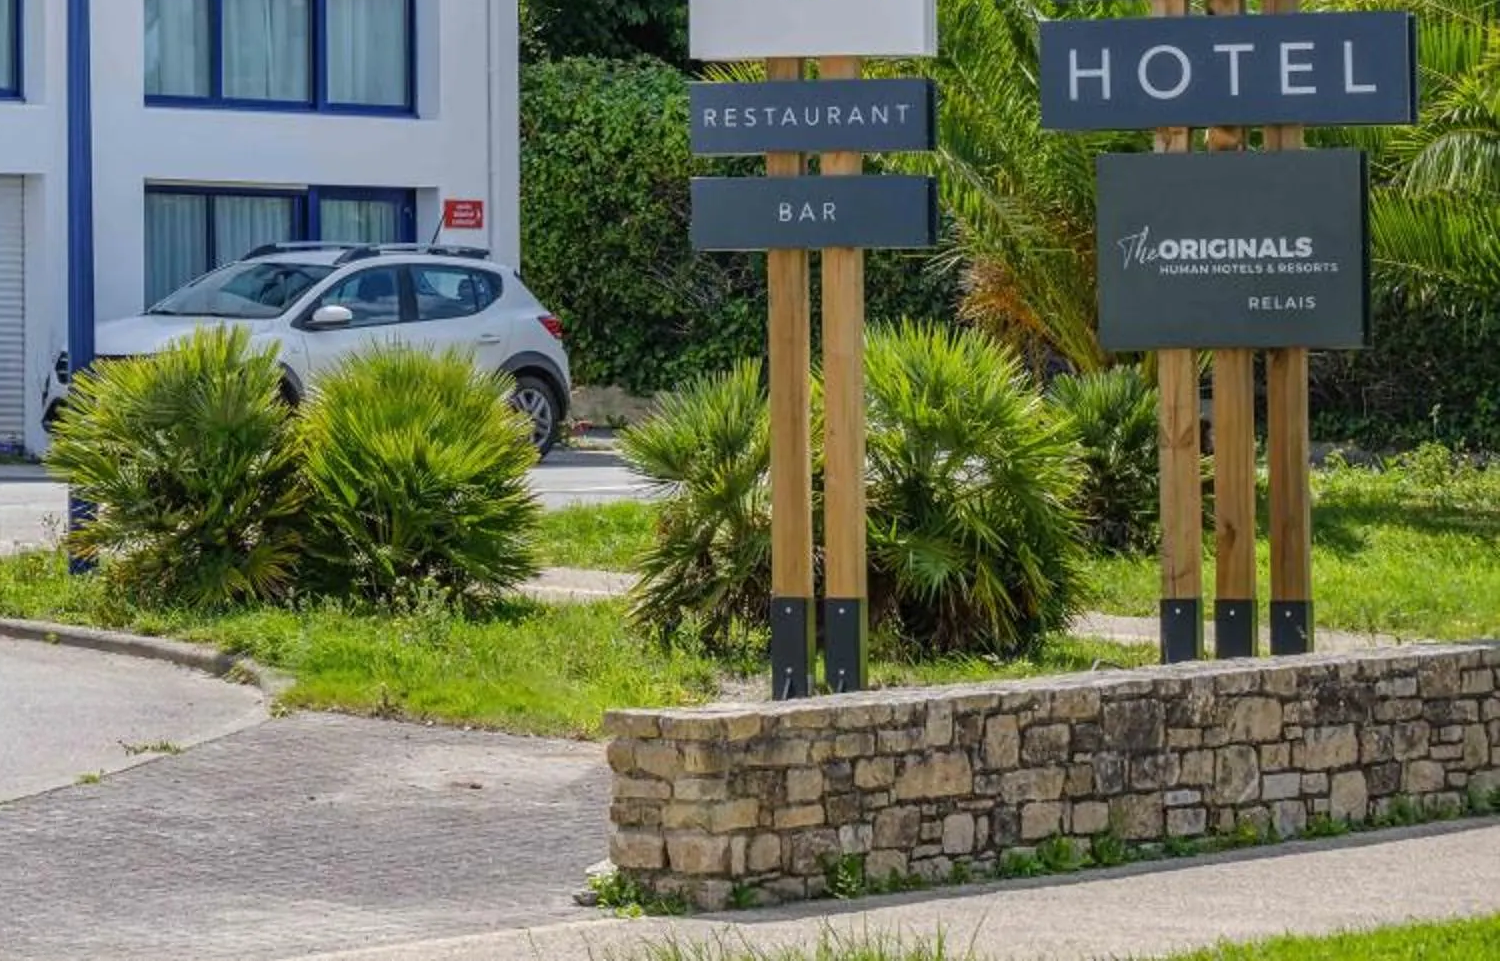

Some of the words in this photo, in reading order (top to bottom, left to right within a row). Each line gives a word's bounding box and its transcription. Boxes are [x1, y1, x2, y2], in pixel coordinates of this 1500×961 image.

[1068, 40, 1377, 101] HOTEL
[703, 104, 911, 128] RESTAURANT
[779, 202, 837, 222] BAR
[1116, 225, 1160, 270] The
[1158, 236, 1314, 261] ORIGINALS
[1159, 263, 1210, 275] HUMAN
[1211, 262, 1264, 274] HOTELS
[1266, 262, 1276, 274] &
[1277, 261, 1340, 274] RESORTS
[1248, 295, 1318, 311] RELAIS
